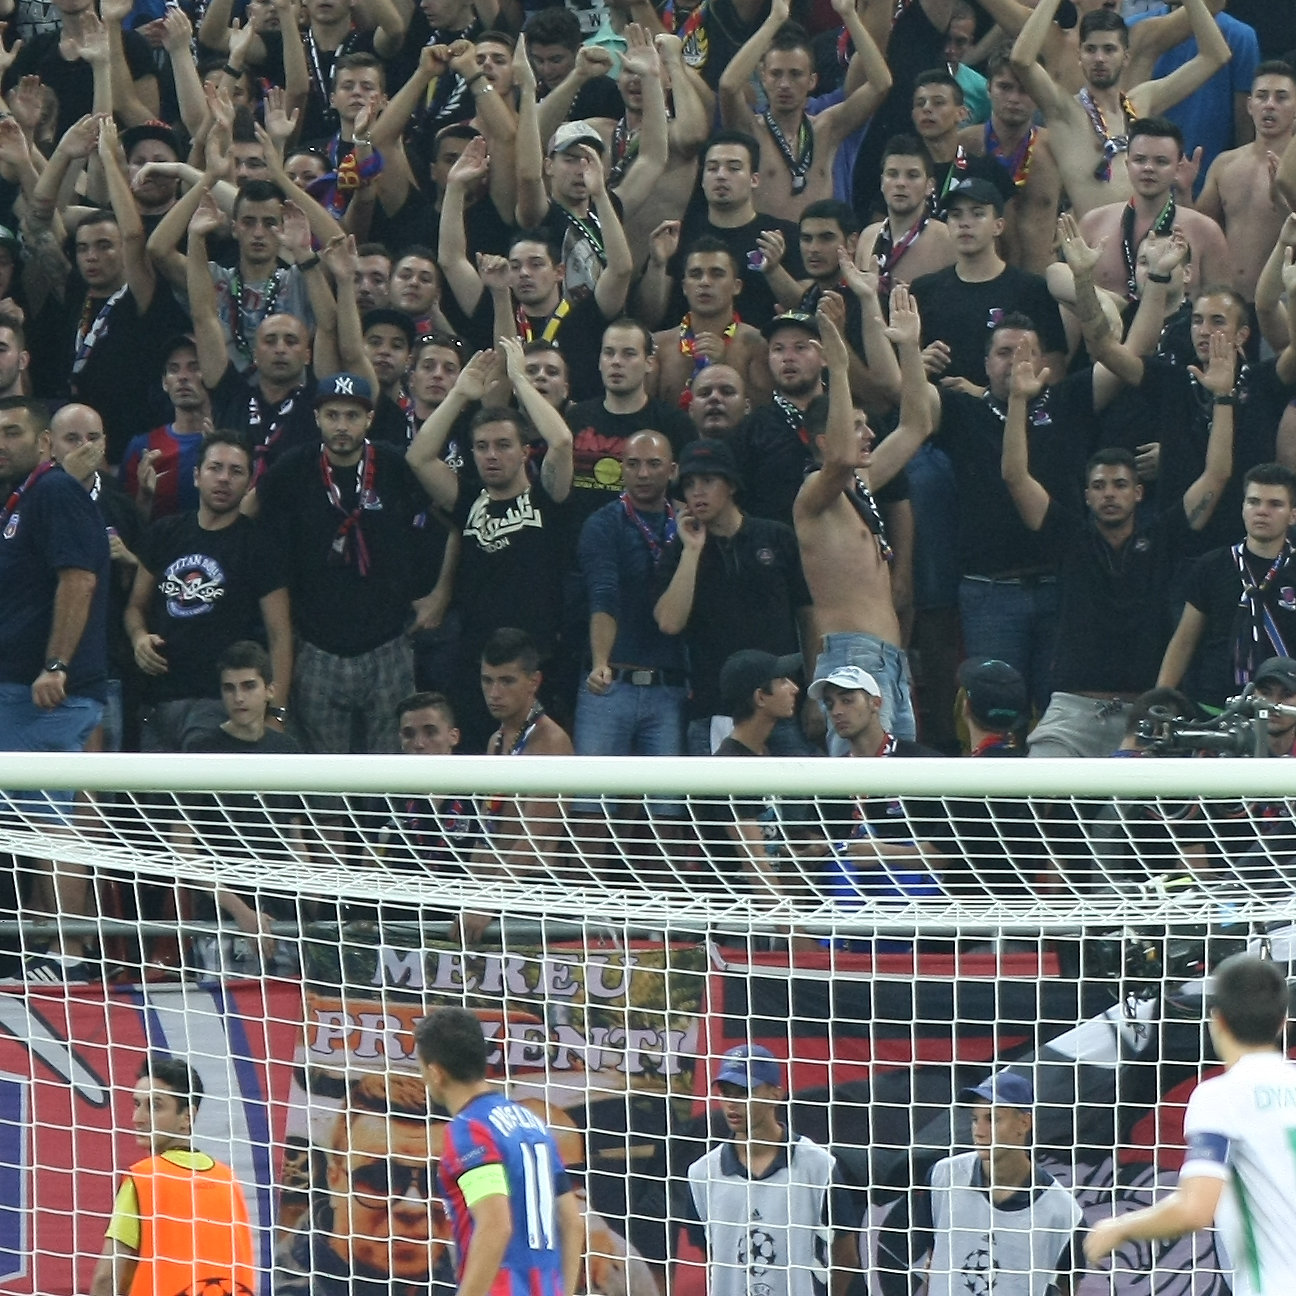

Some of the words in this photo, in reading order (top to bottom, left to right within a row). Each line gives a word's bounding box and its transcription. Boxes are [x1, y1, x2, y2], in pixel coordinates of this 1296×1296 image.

[371, 947, 639, 1000] MEREU
[310, 1005, 692, 1075] PRZENTI
[519, 1141, 556, 1251] 11
